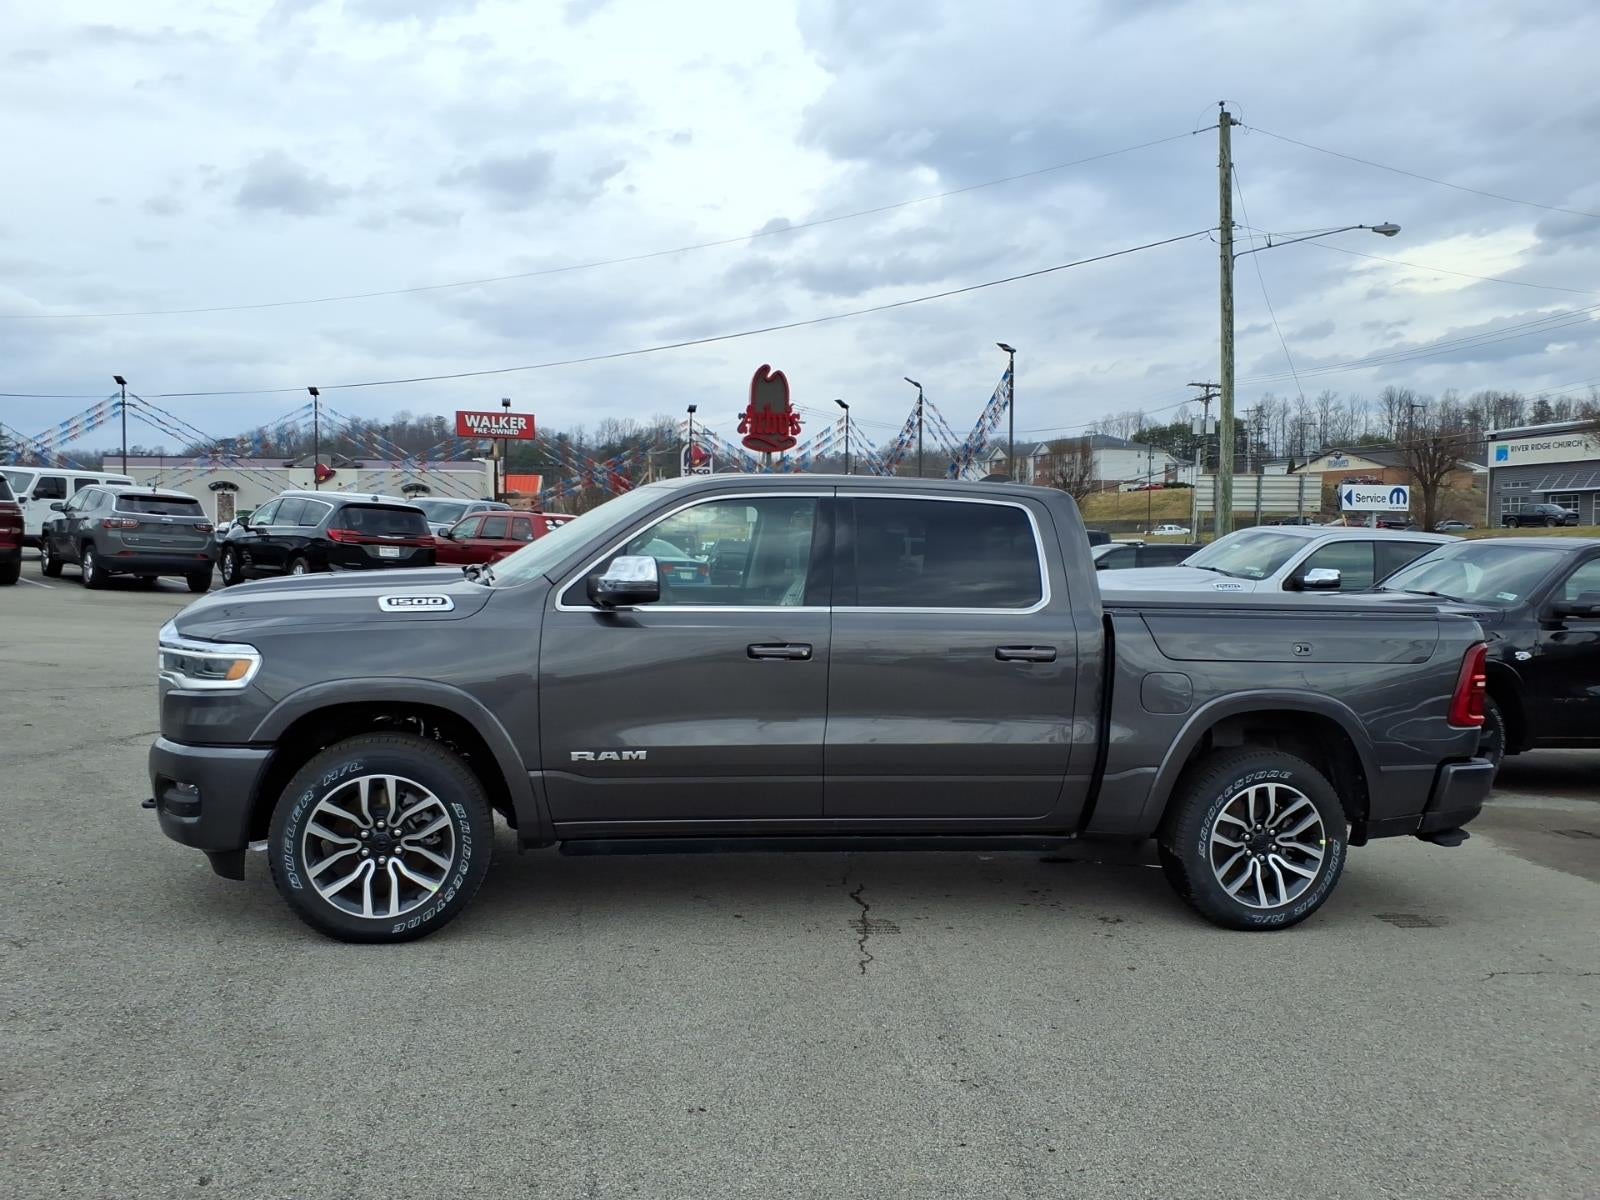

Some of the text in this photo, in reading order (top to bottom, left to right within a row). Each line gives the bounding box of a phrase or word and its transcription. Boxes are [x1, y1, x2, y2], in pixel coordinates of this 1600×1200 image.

[464, 414, 527, 430] WALKER
[473, 427, 520, 436] PRE-OWNED
[1510, 439, 1583, 453] RIVER RIDGE CHURCH
[682, 468, 711, 476] TACO
[1355, 492, 1387, 504] Service
[389, 598, 444, 606] 1500
[570, 750, 647, 761] RAM
[1198, 769, 1294, 860] BRIDGESTONE
[284, 789, 315, 890] DUELER
[391, 802, 473, 935] BRIDGESTONE
